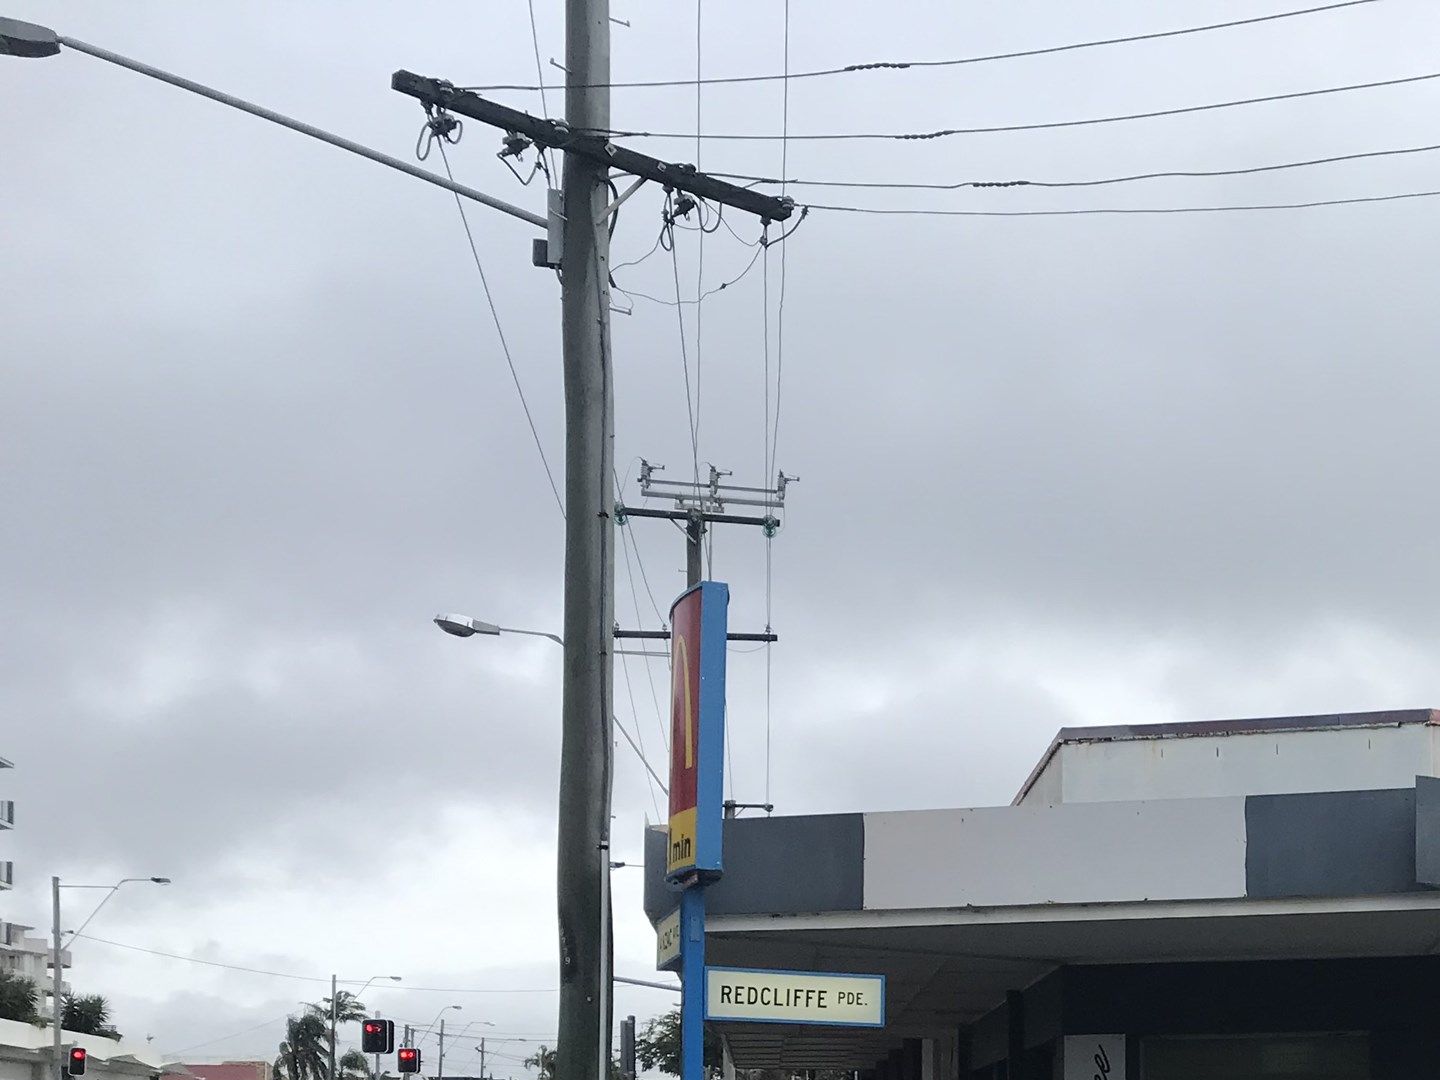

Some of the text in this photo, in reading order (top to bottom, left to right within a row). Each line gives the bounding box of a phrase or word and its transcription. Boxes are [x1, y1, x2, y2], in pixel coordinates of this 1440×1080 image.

[672, 833, 691, 864] min
[720, 985, 868, 1009] REDCLIFFE PDE.
